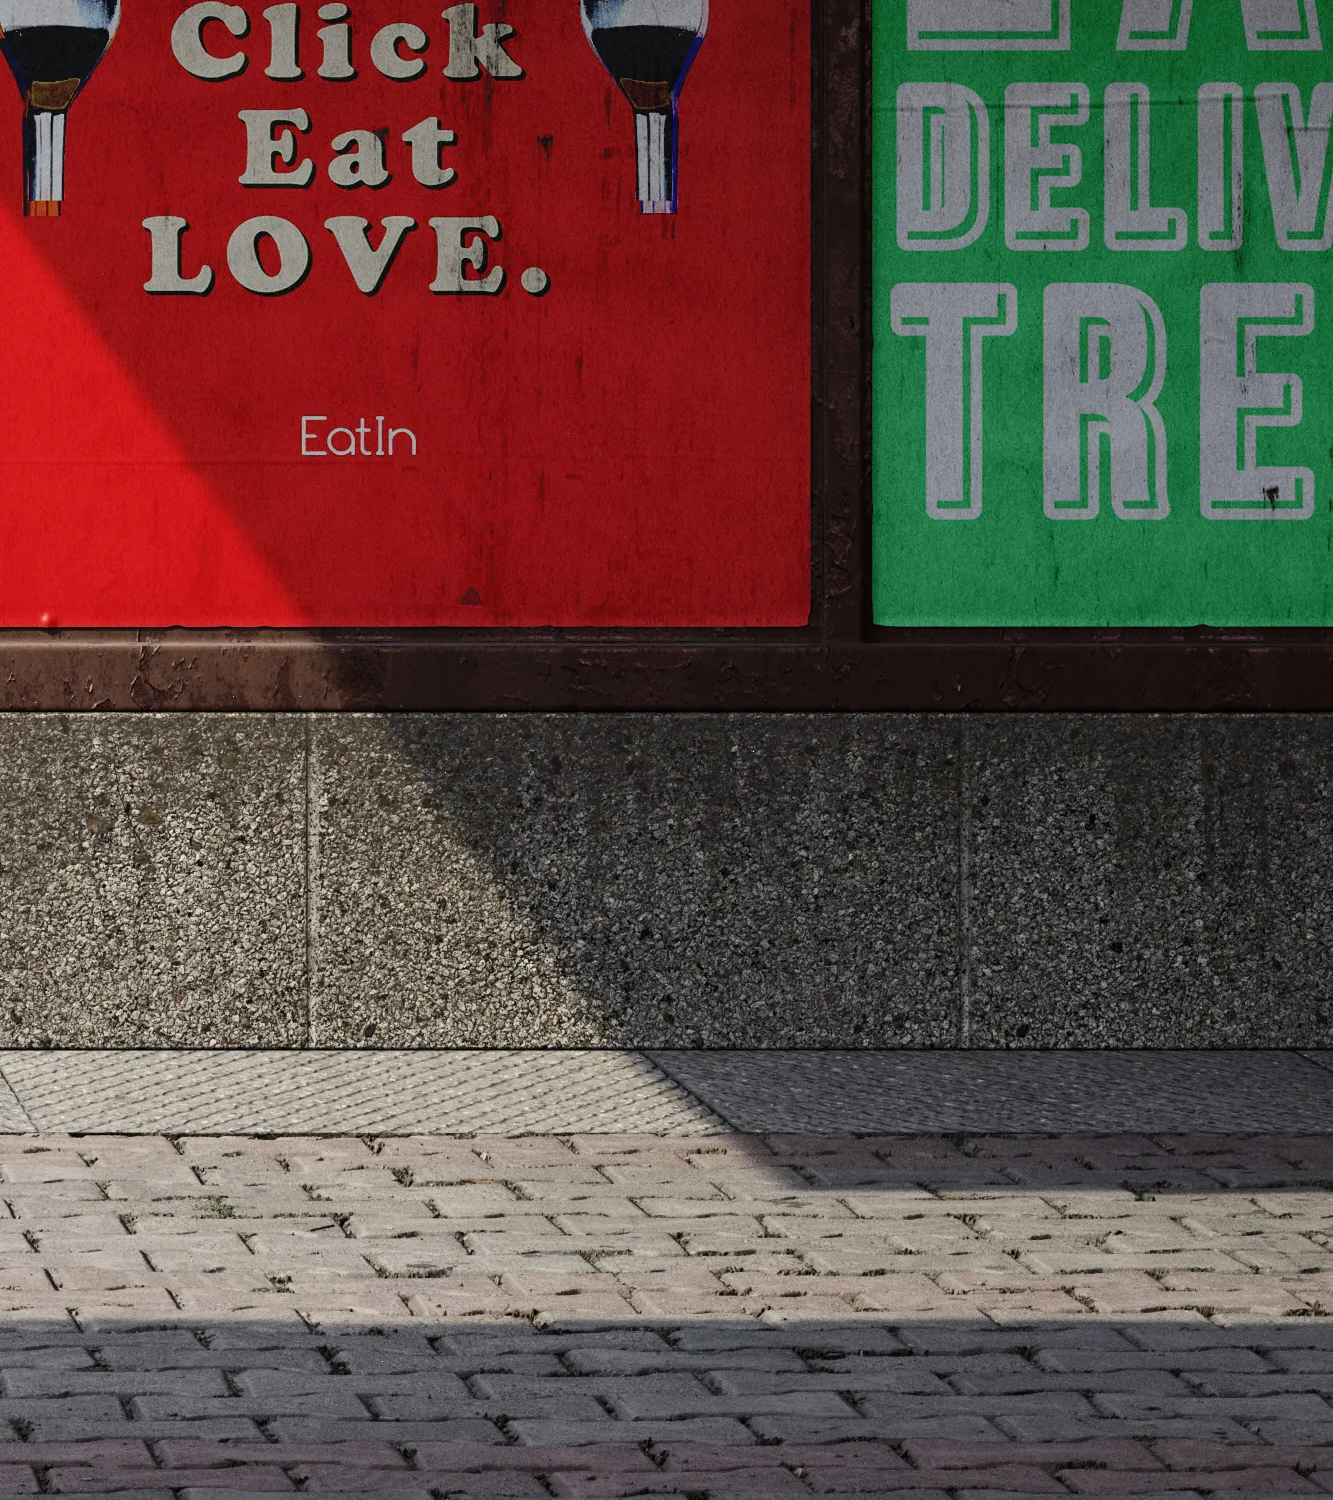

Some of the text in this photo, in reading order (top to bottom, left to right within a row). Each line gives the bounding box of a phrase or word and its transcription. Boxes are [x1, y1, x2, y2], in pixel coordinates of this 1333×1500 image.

[170, 0, 525, 81] Click
[237, 107, 457, 188] Eat
[895, 81, 1333, 252] DELIV
[141, 214, 549, 295] LOVE.
[301, 415, 417, 456] EatIn
[889, 280, 1316, 522] TRE
